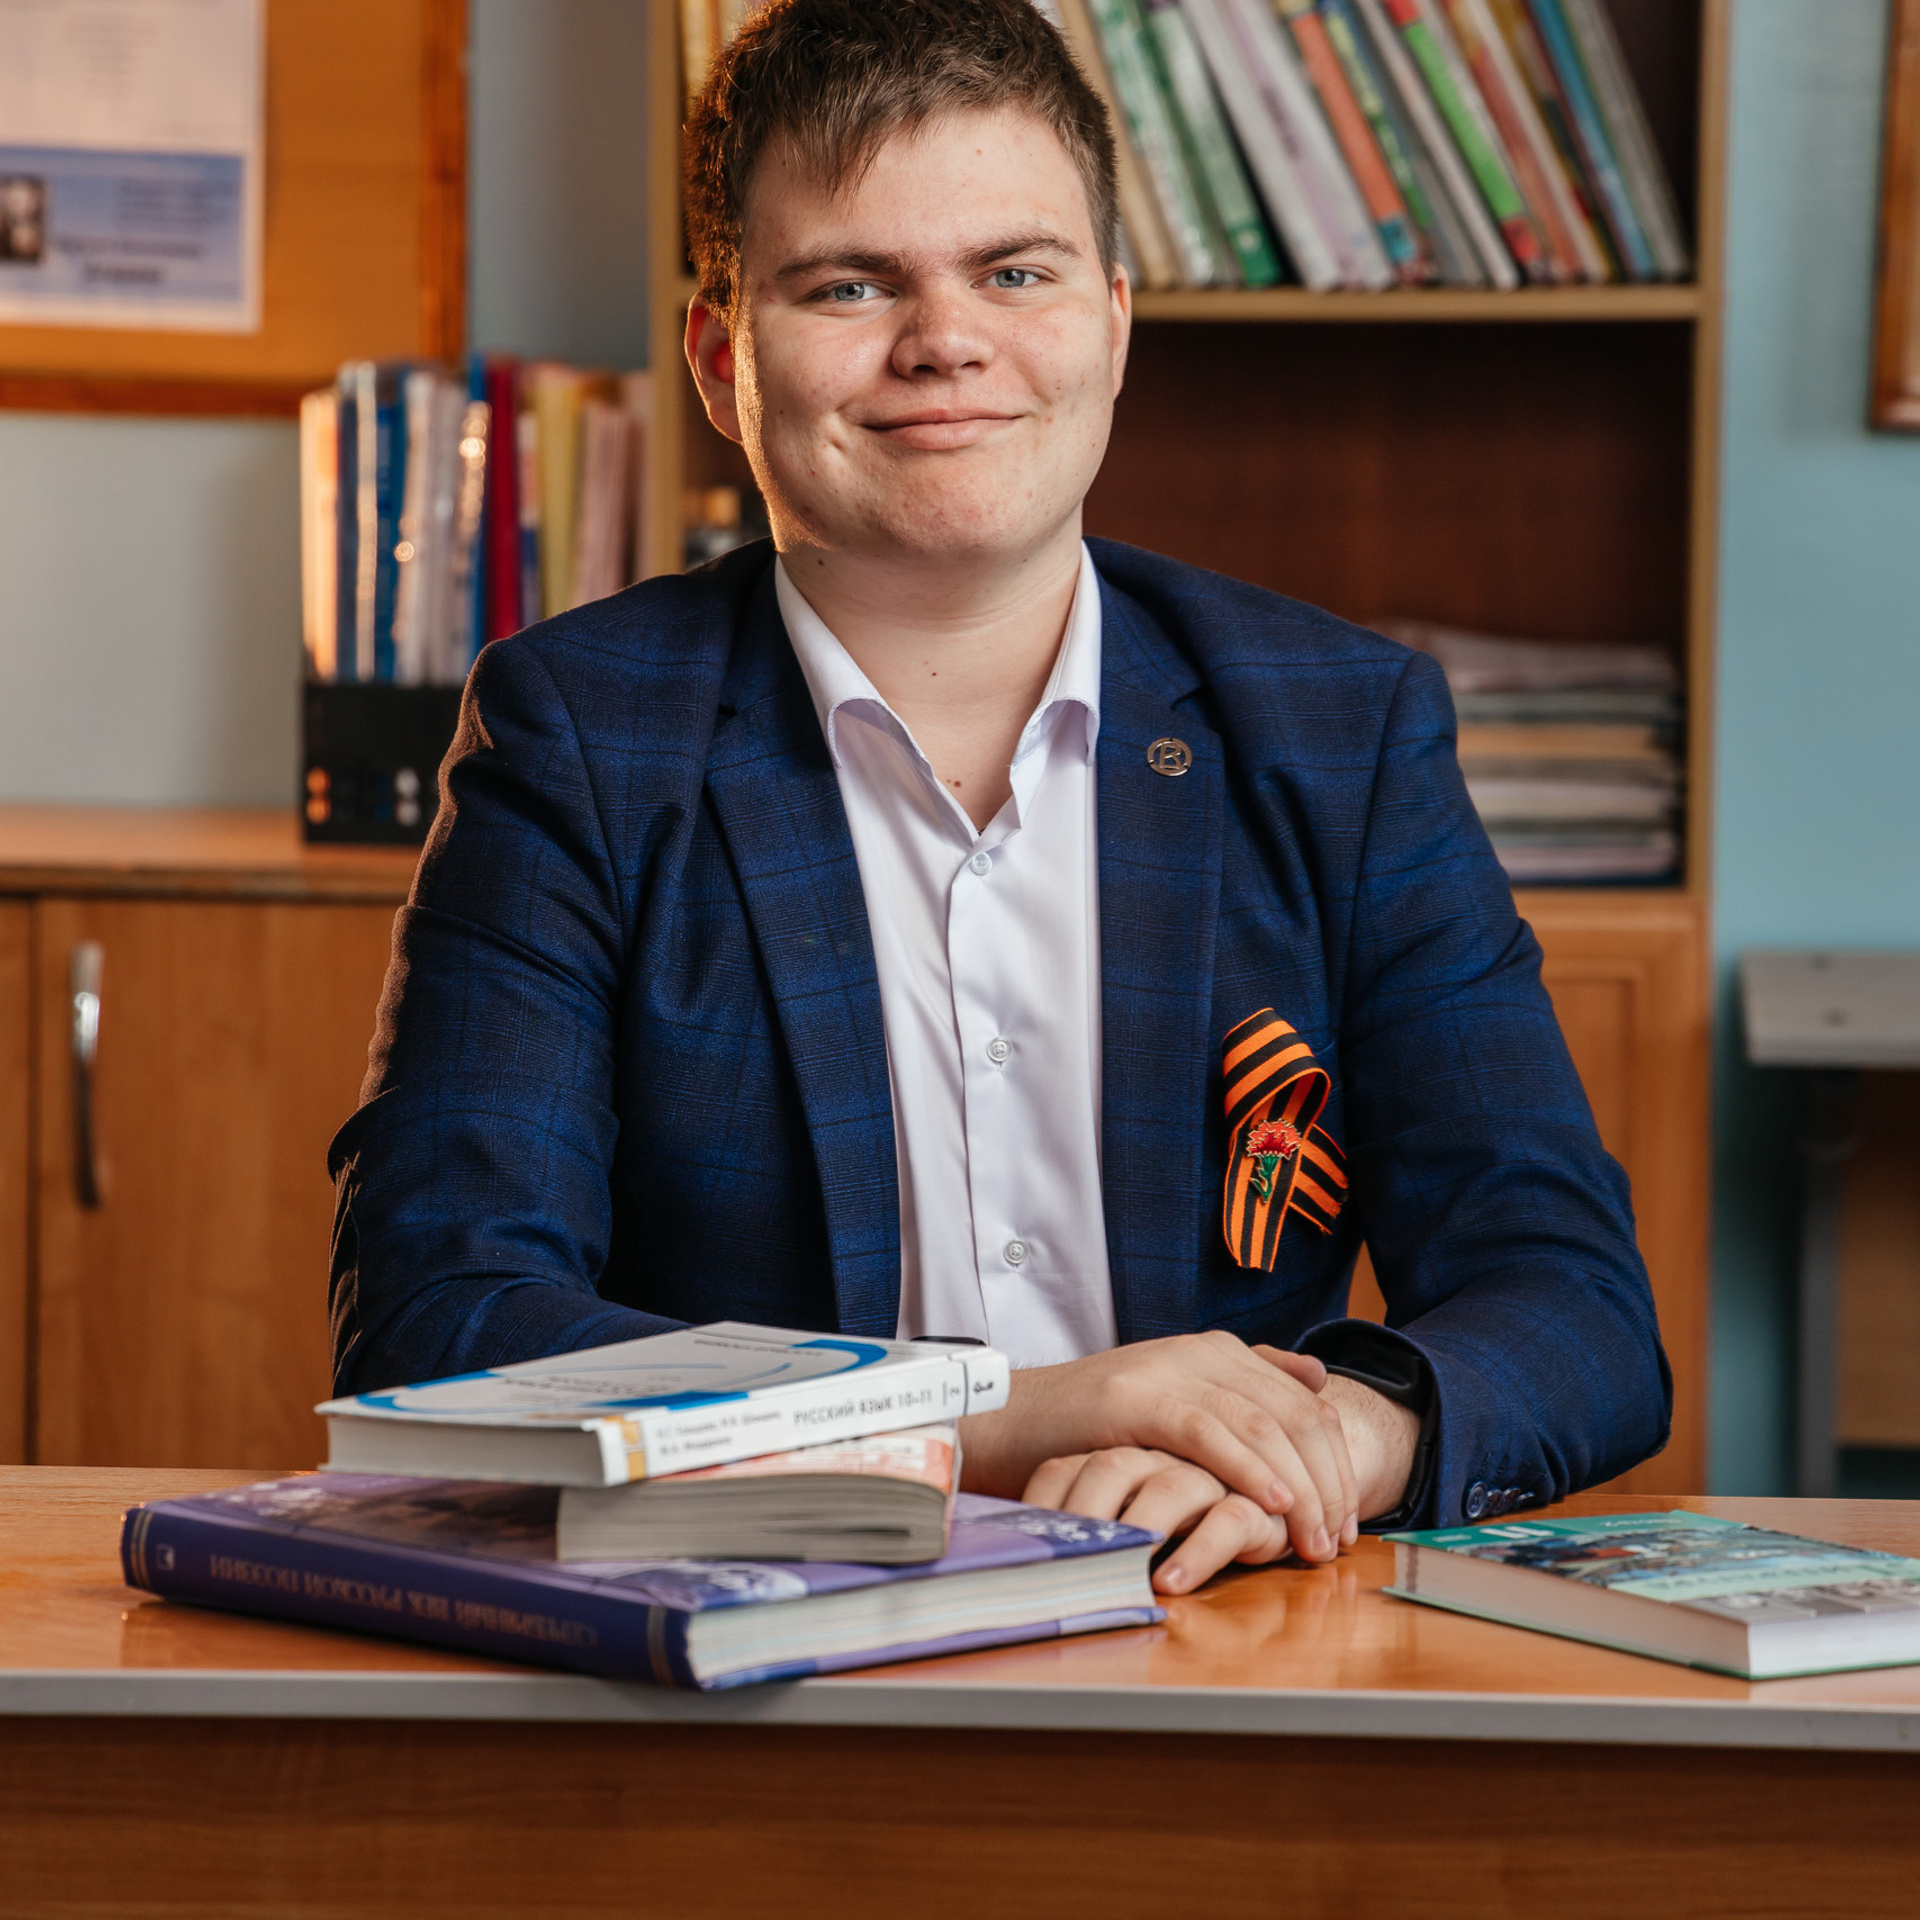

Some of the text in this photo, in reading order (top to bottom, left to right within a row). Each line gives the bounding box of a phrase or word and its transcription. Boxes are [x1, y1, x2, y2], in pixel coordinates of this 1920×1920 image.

[793, 1398, 857, 1426] РУССКИЙ
[859, 1396, 893, 1415] ЯЗЫК
[208, 1553, 299, 1592] ПОЭЗИИ
[303, 1571, 403, 1611] РУССКОЙ
[406, 1590, 450, 1622] ВЕК
